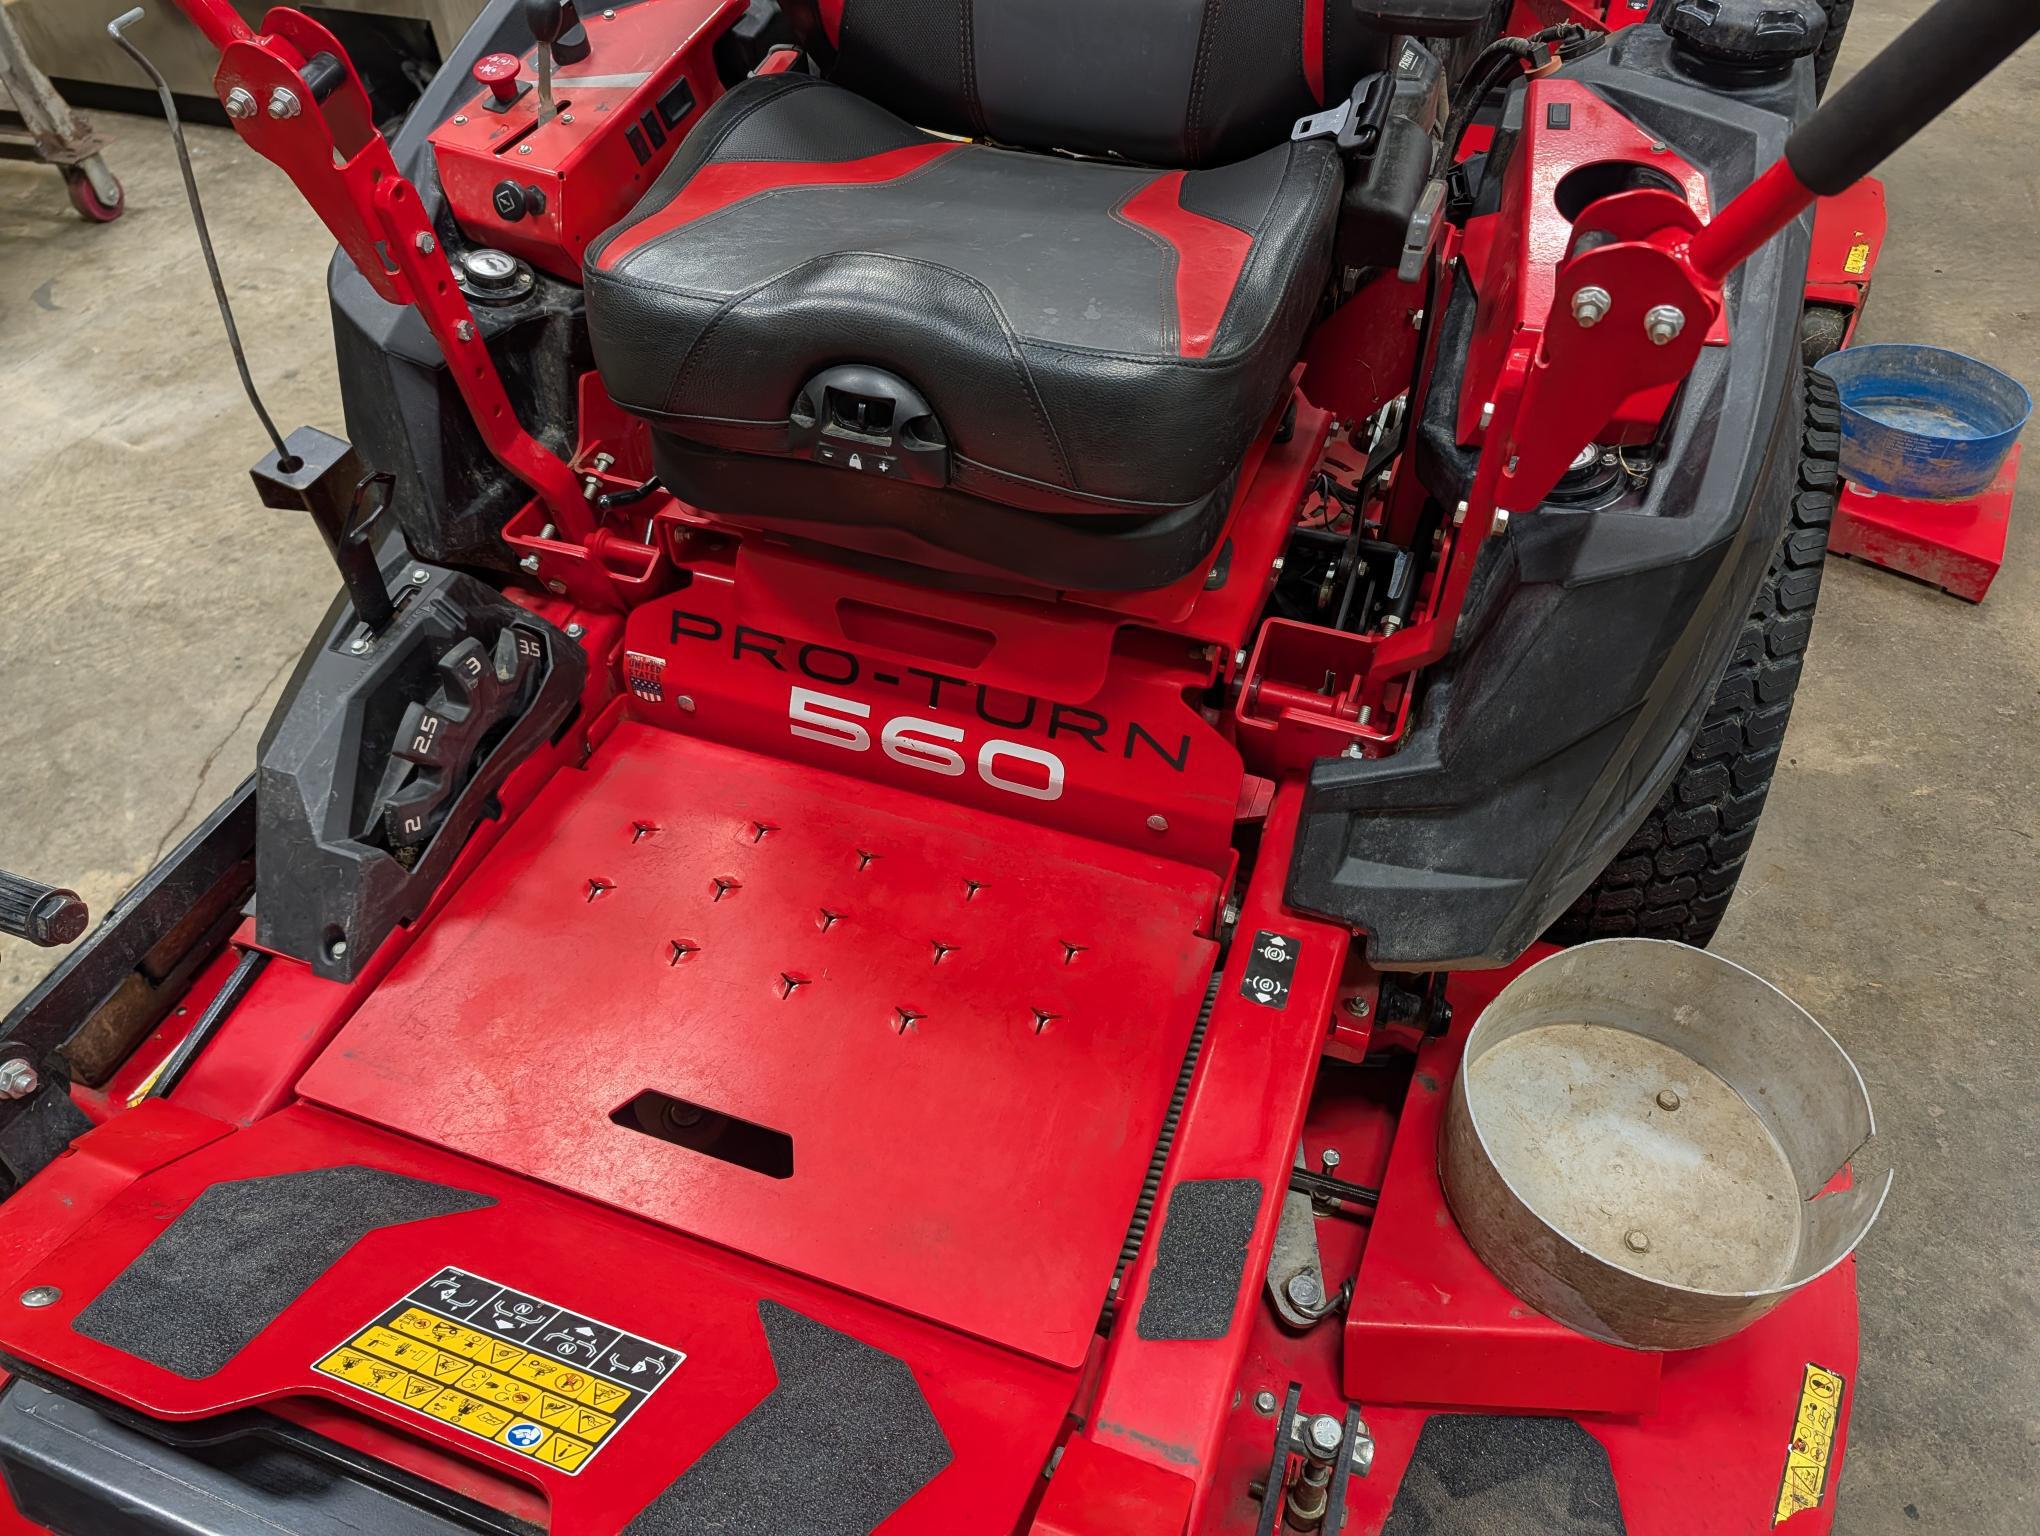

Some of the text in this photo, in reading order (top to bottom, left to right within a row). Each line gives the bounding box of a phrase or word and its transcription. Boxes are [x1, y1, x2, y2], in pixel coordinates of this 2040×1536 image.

[465, 656, 482, 675] 3
[629, 659, 662, 674] UNITED
[670, 609, 1191, 772] PRO-TURN
[412, 715, 439, 754] 2.5
[788, 685, 1065, 801] 560
[404, 815, 422, 834] 2
